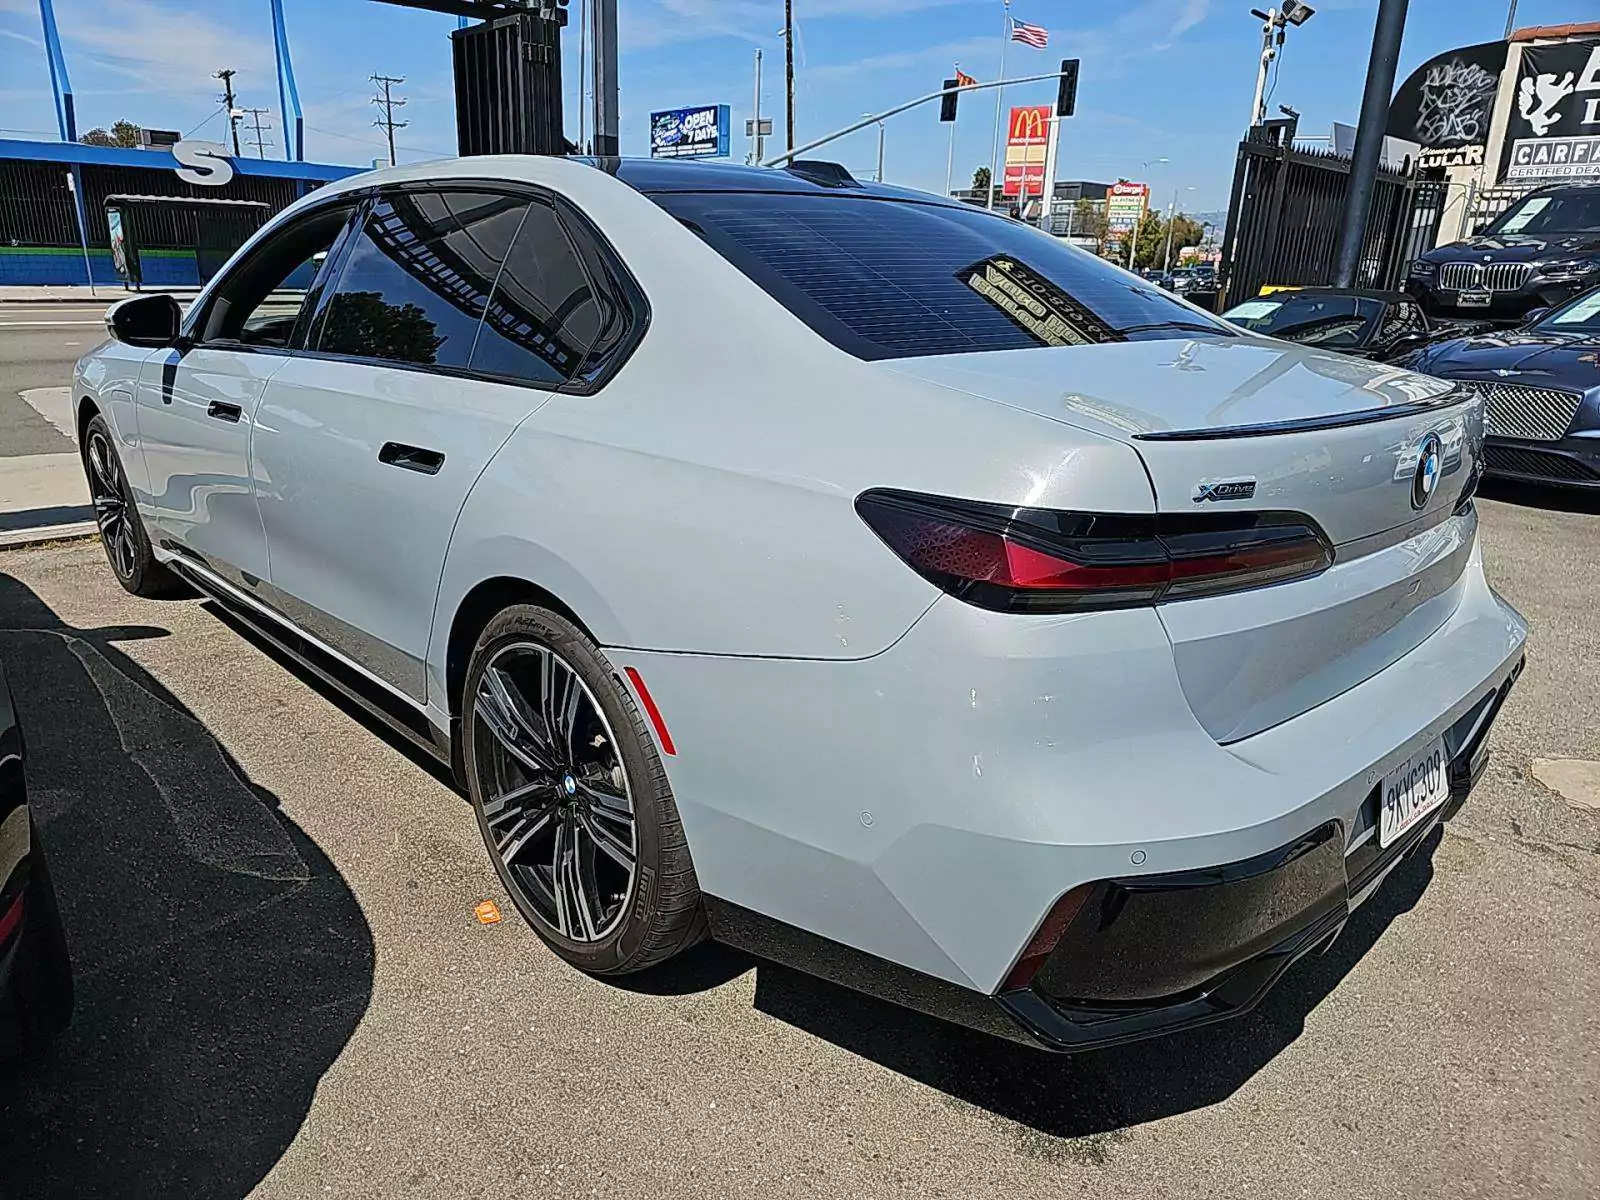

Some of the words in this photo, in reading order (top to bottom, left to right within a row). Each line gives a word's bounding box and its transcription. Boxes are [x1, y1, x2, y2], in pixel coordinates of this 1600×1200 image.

[684, 109, 714, 130] OPEN
[688, 130, 695, 143] 7
[695, 125, 717, 141] DAYS
[172, 140, 233, 186] S
[1510, 167, 1572, 177] CERTIFIED
[1387, 748, 1441, 832] 9KYC309
